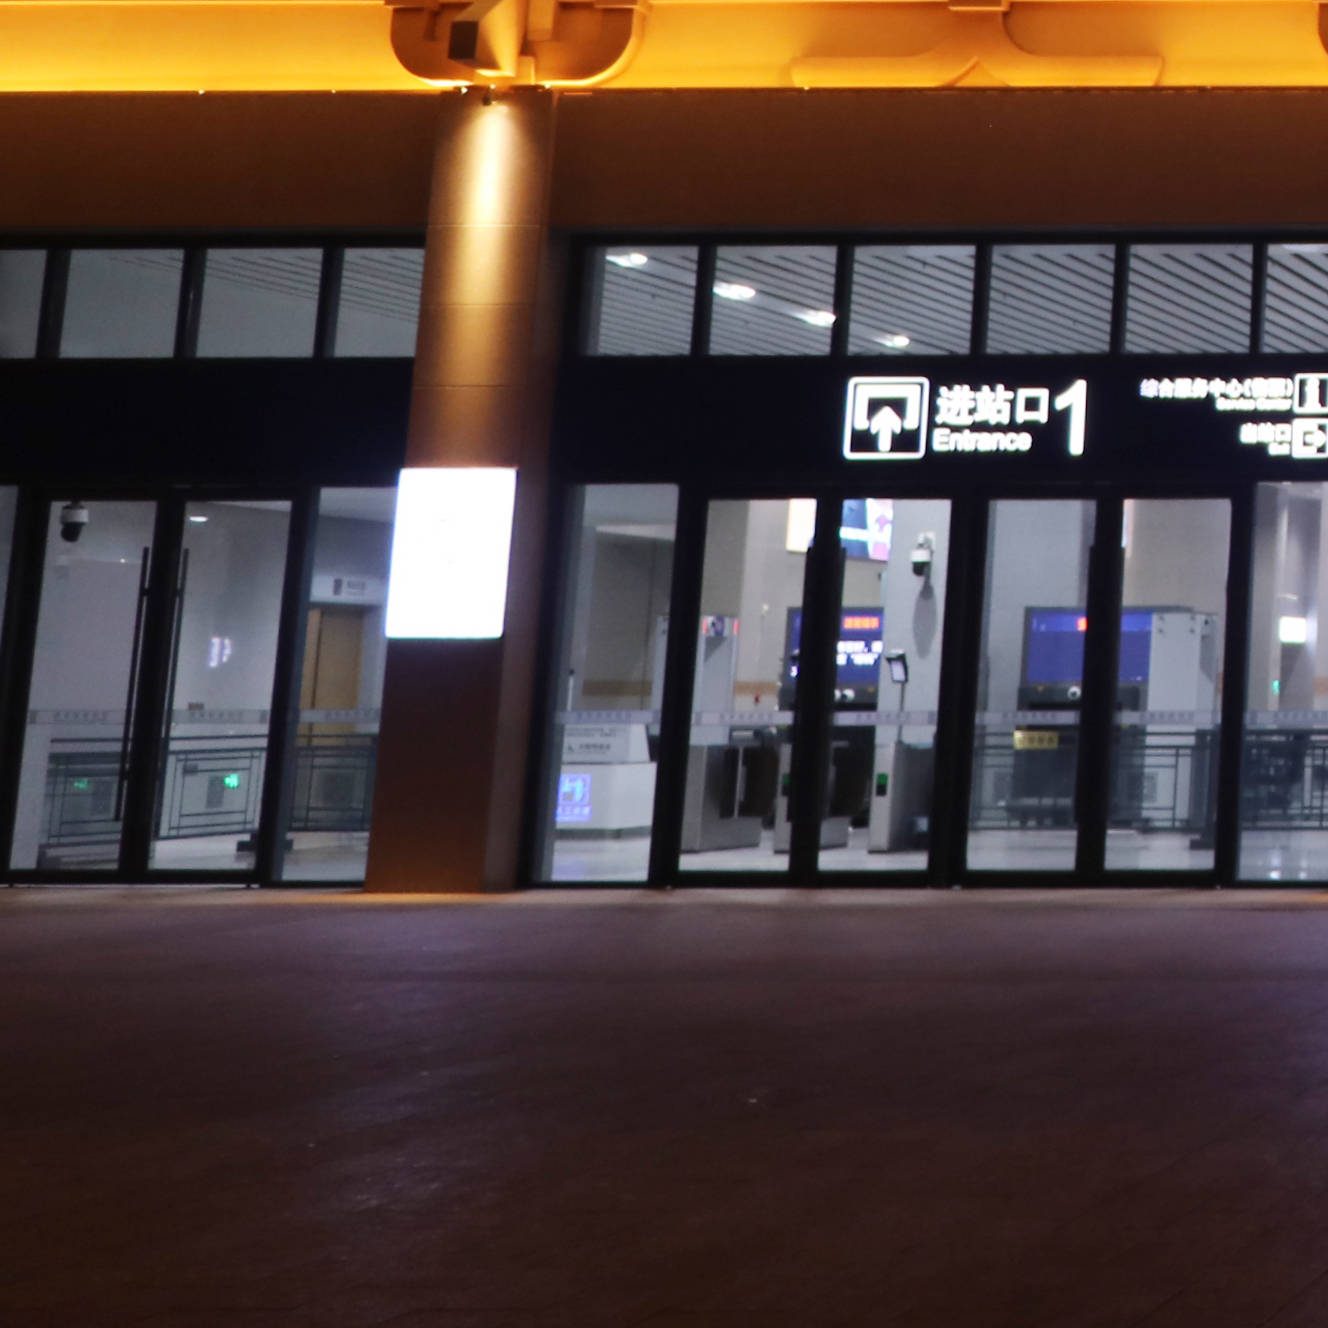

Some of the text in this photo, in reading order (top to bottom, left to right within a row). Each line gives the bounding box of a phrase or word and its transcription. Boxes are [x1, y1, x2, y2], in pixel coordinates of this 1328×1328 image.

[934, 383, 1050, 426] 进站口
[932, 428, 1033, 452] Entrance
